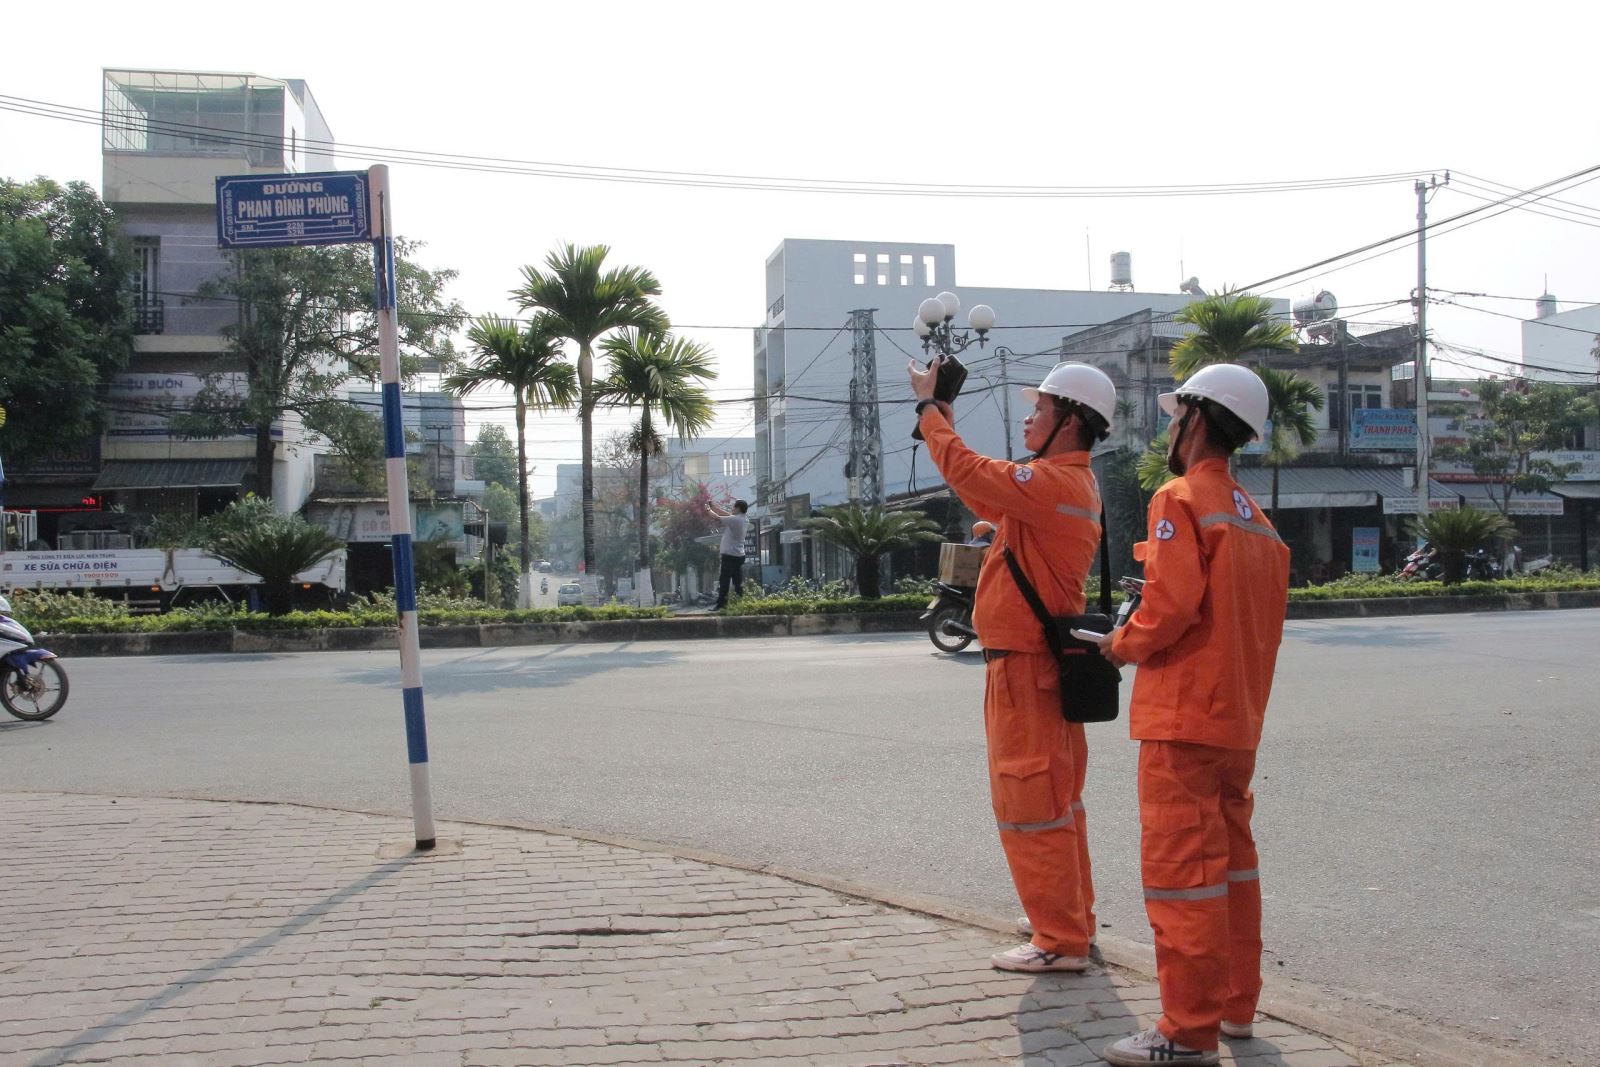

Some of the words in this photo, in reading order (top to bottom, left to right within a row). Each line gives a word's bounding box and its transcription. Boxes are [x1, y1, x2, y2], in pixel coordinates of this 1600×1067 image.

[263, 182, 323, 195] ĐƯỜNG
[238, 200, 273, 218] PHAN
[275, 195, 304, 216] ĐÌNH
[307, 194, 349, 215] PHÙNG
[286, 222, 304, 230] 22M
[24, 563, 37, 571] XE
[40, 561, 60, 571] SỬA
[62, 561, 91, 570] CHỮA
[93, 561, 118, 571] ĐIỆN
